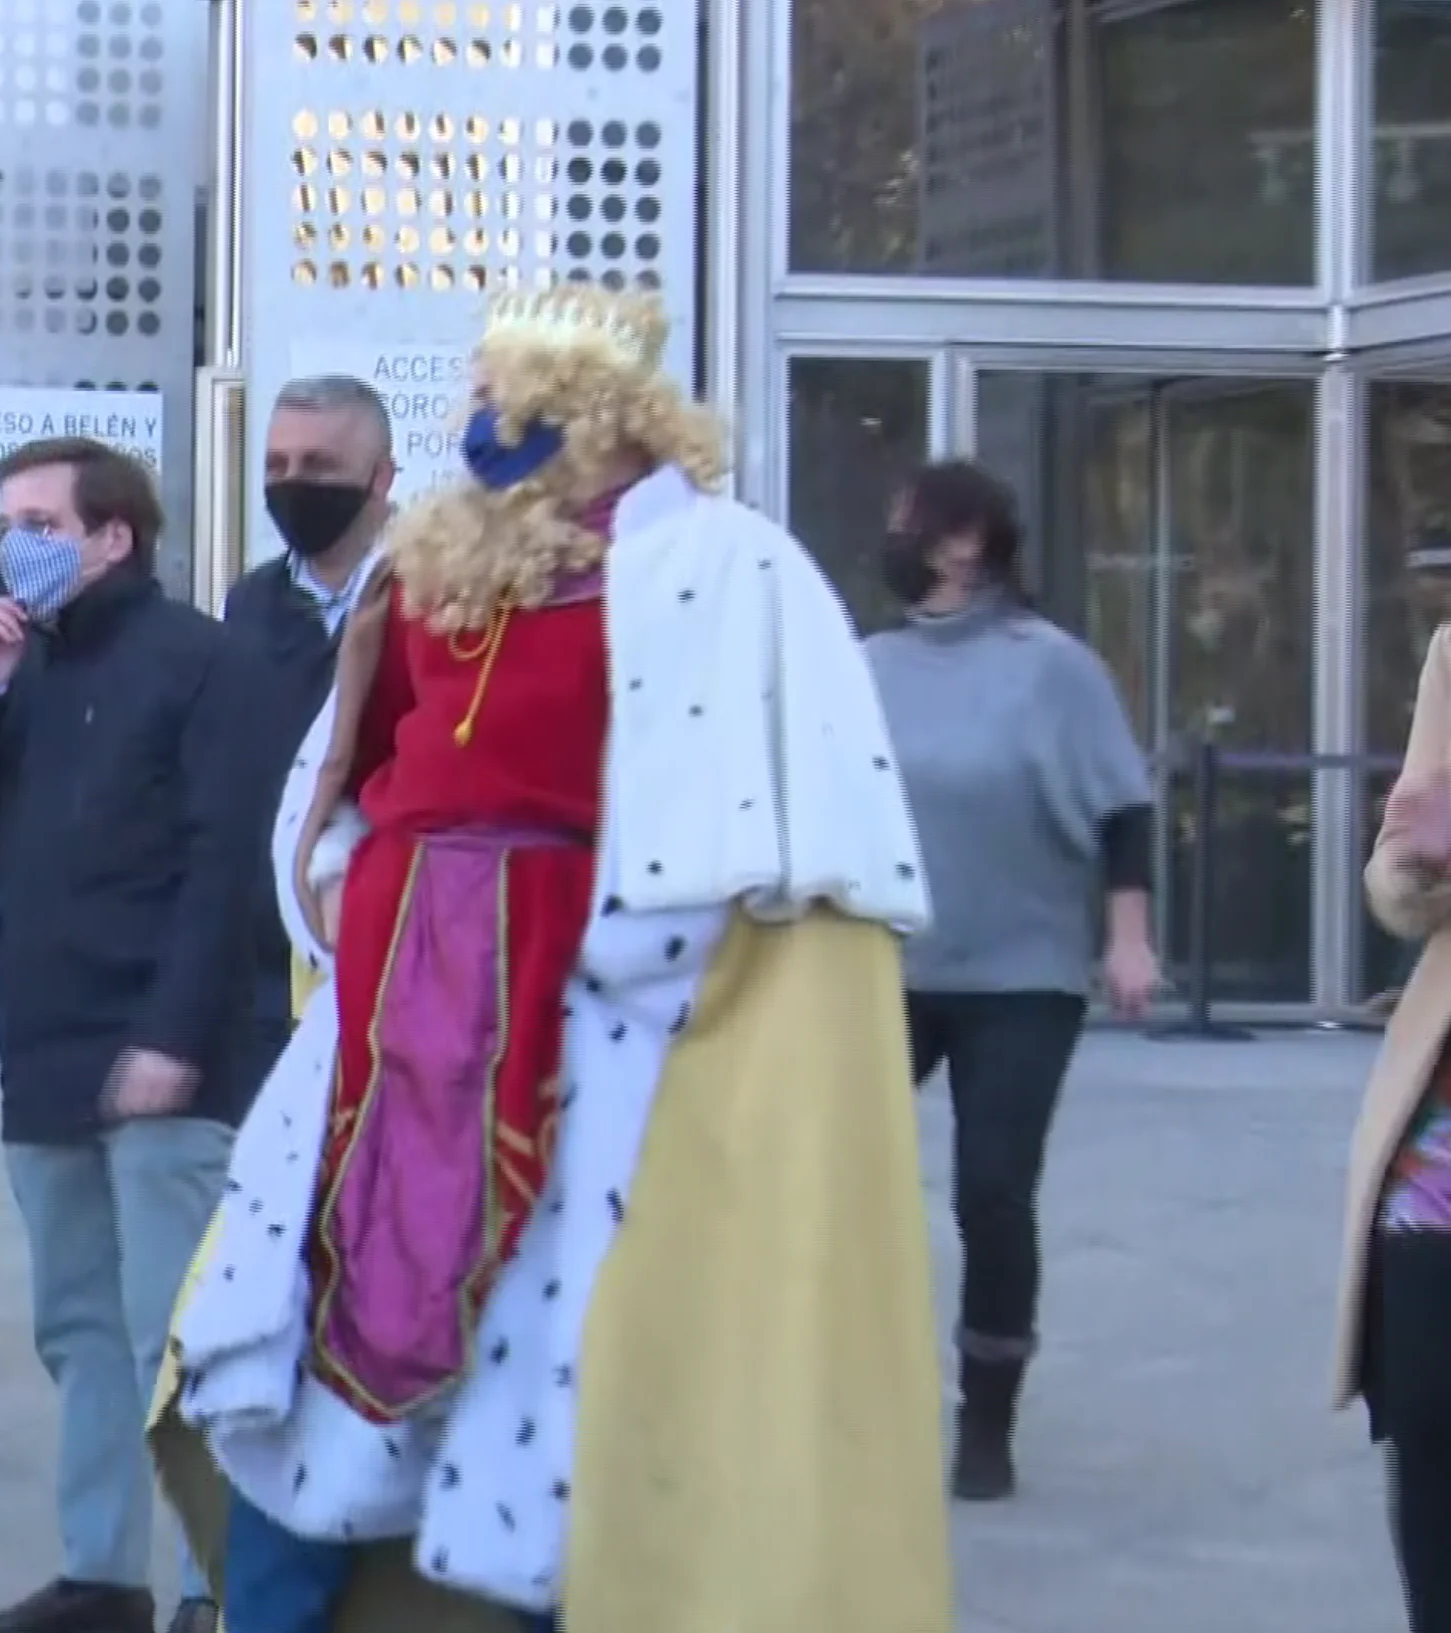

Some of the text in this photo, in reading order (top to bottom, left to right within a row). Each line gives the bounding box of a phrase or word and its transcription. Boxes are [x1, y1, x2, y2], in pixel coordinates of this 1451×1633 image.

[374, 354, 466, 382] ACCES
[40, 413, 54, 434] A
[64, 412, 136, 437] BELÉN
[145, 417, 157, 437] Y
